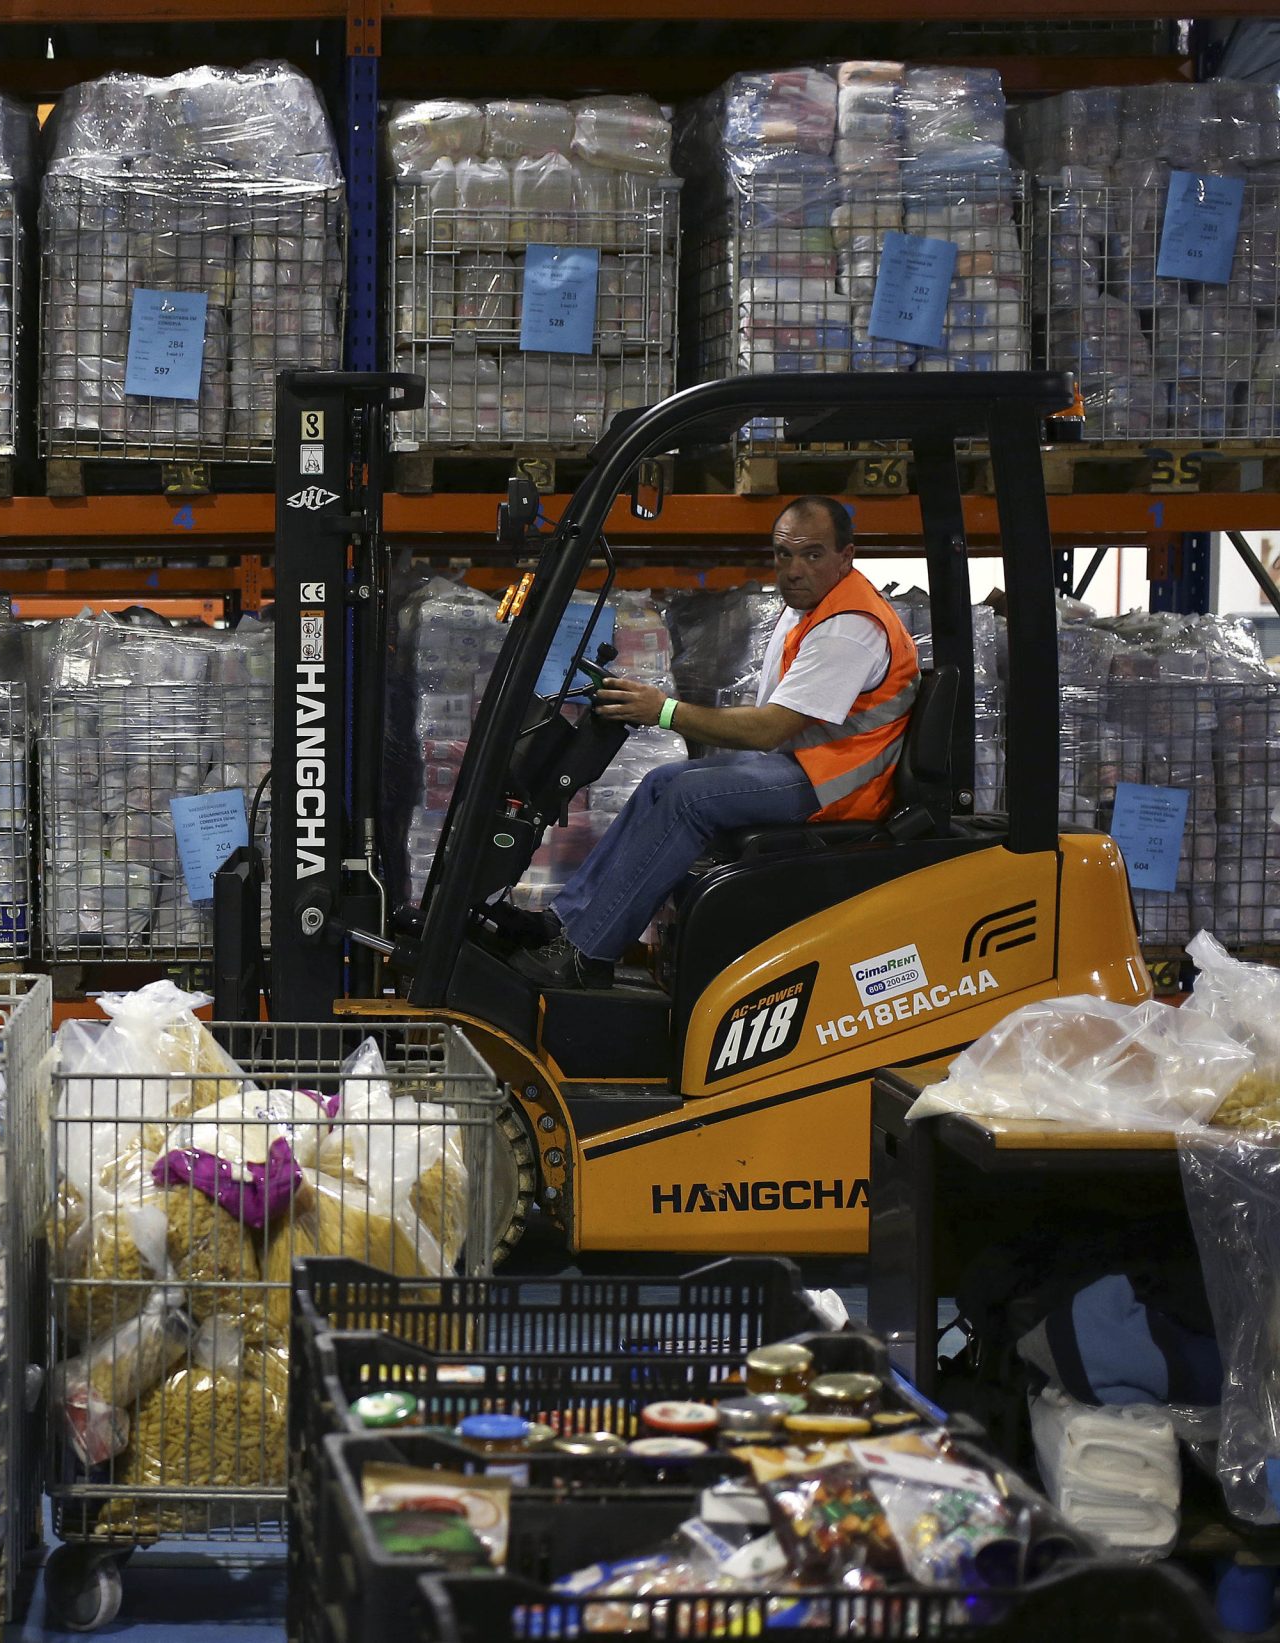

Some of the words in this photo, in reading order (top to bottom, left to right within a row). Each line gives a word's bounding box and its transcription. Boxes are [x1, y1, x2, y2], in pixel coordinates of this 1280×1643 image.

[1187, 249, 1203, 258] 615
[549, 318, 565, 328] 528
[898, 310, 913, 321] 715
[153, 366, 170, 375] 597
[863, 460, 902, 488] 56
[172, 503, 197, 530] 4
[1147, 500, 1165, 529] 1
[302, 584, 324, 600] CE
[296, 664, 326, 880] HANGCHA
[216, 842, 231, 852] 2C4
[1133, 862, 1149, 871] 604
[855, 954, 917, 982] CimaRENT
[730, 982, 804, 1021] AC-POWER
[868, 983, 884, 994] 808
[815, 969, 1000, 1046] HC18EAC-4A
[714, 997, 799, 1071] A18
[652, 1178, 870, 1214] HANGCHA
